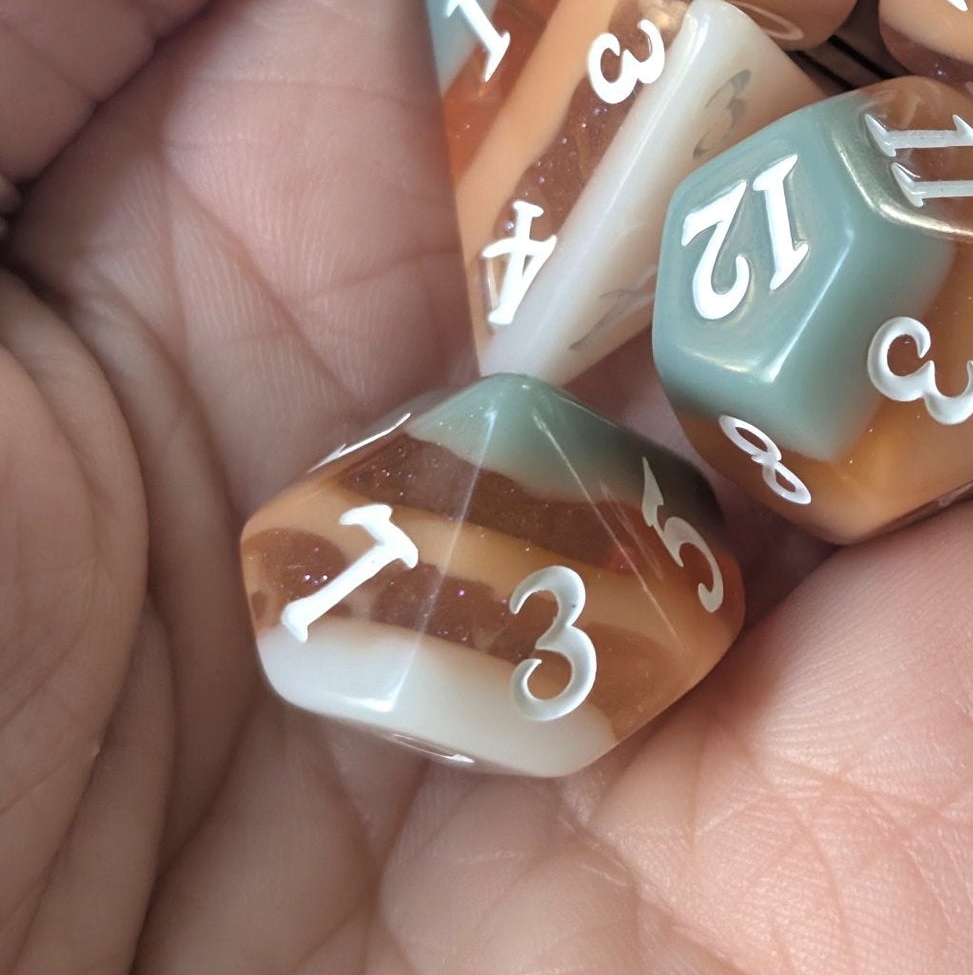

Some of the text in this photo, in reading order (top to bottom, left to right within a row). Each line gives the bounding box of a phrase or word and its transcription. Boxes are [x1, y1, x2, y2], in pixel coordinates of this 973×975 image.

[587, 19, 666, 104] 3
[483, 201, 557, 324] 4
[681, 154, 809, 320] 12
[718, 414, 812, 505] 8
[281, 503, 419, 643] 1
[641, 457, 724, 614] 5
[509, 564, 597, 721] 3
